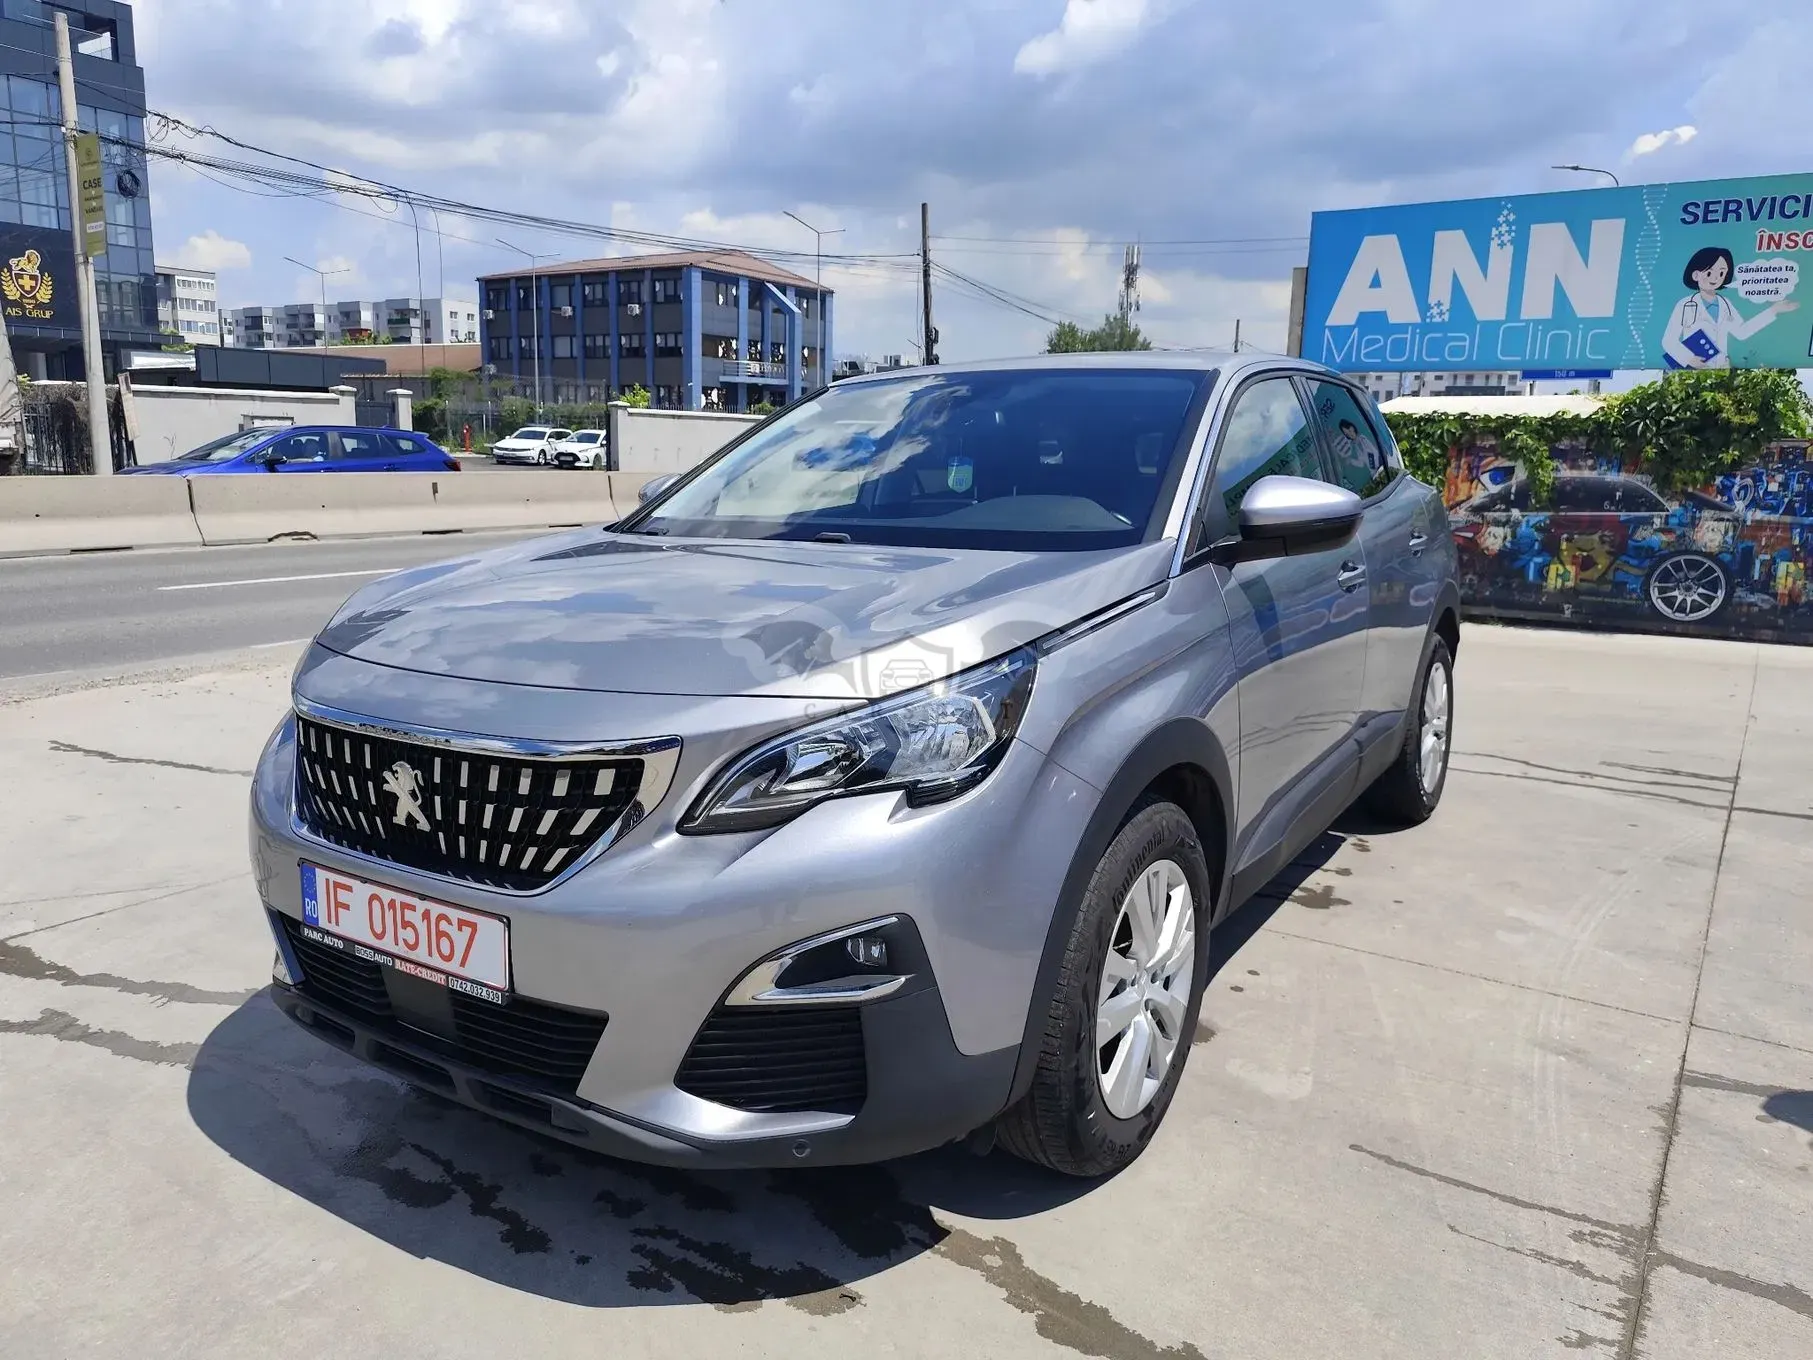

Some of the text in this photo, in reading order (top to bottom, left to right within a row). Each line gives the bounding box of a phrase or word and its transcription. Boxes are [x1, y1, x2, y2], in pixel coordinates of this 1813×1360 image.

[83, 178, 102, 190] CASE
[1325, 217, 1626, 326] ANN
[1737, 264, 1797, 274] Sănătatea ta,
[1741, 276, 1789, 287] prioritatea
[1745, 288, 1782, 297] noastră.
[5, 306, 54, 319] AIS GRUP
[1322, 321, 1610, 364] Medical Clinic
[304, 898, 319, 919] RO
[325, 878, 478, 969] IF 015167
[303, 927, 323, 942] PARC
[323, 935, 344, 950] AUTO
[450, 976, 501, 1003] 0742.032.939
